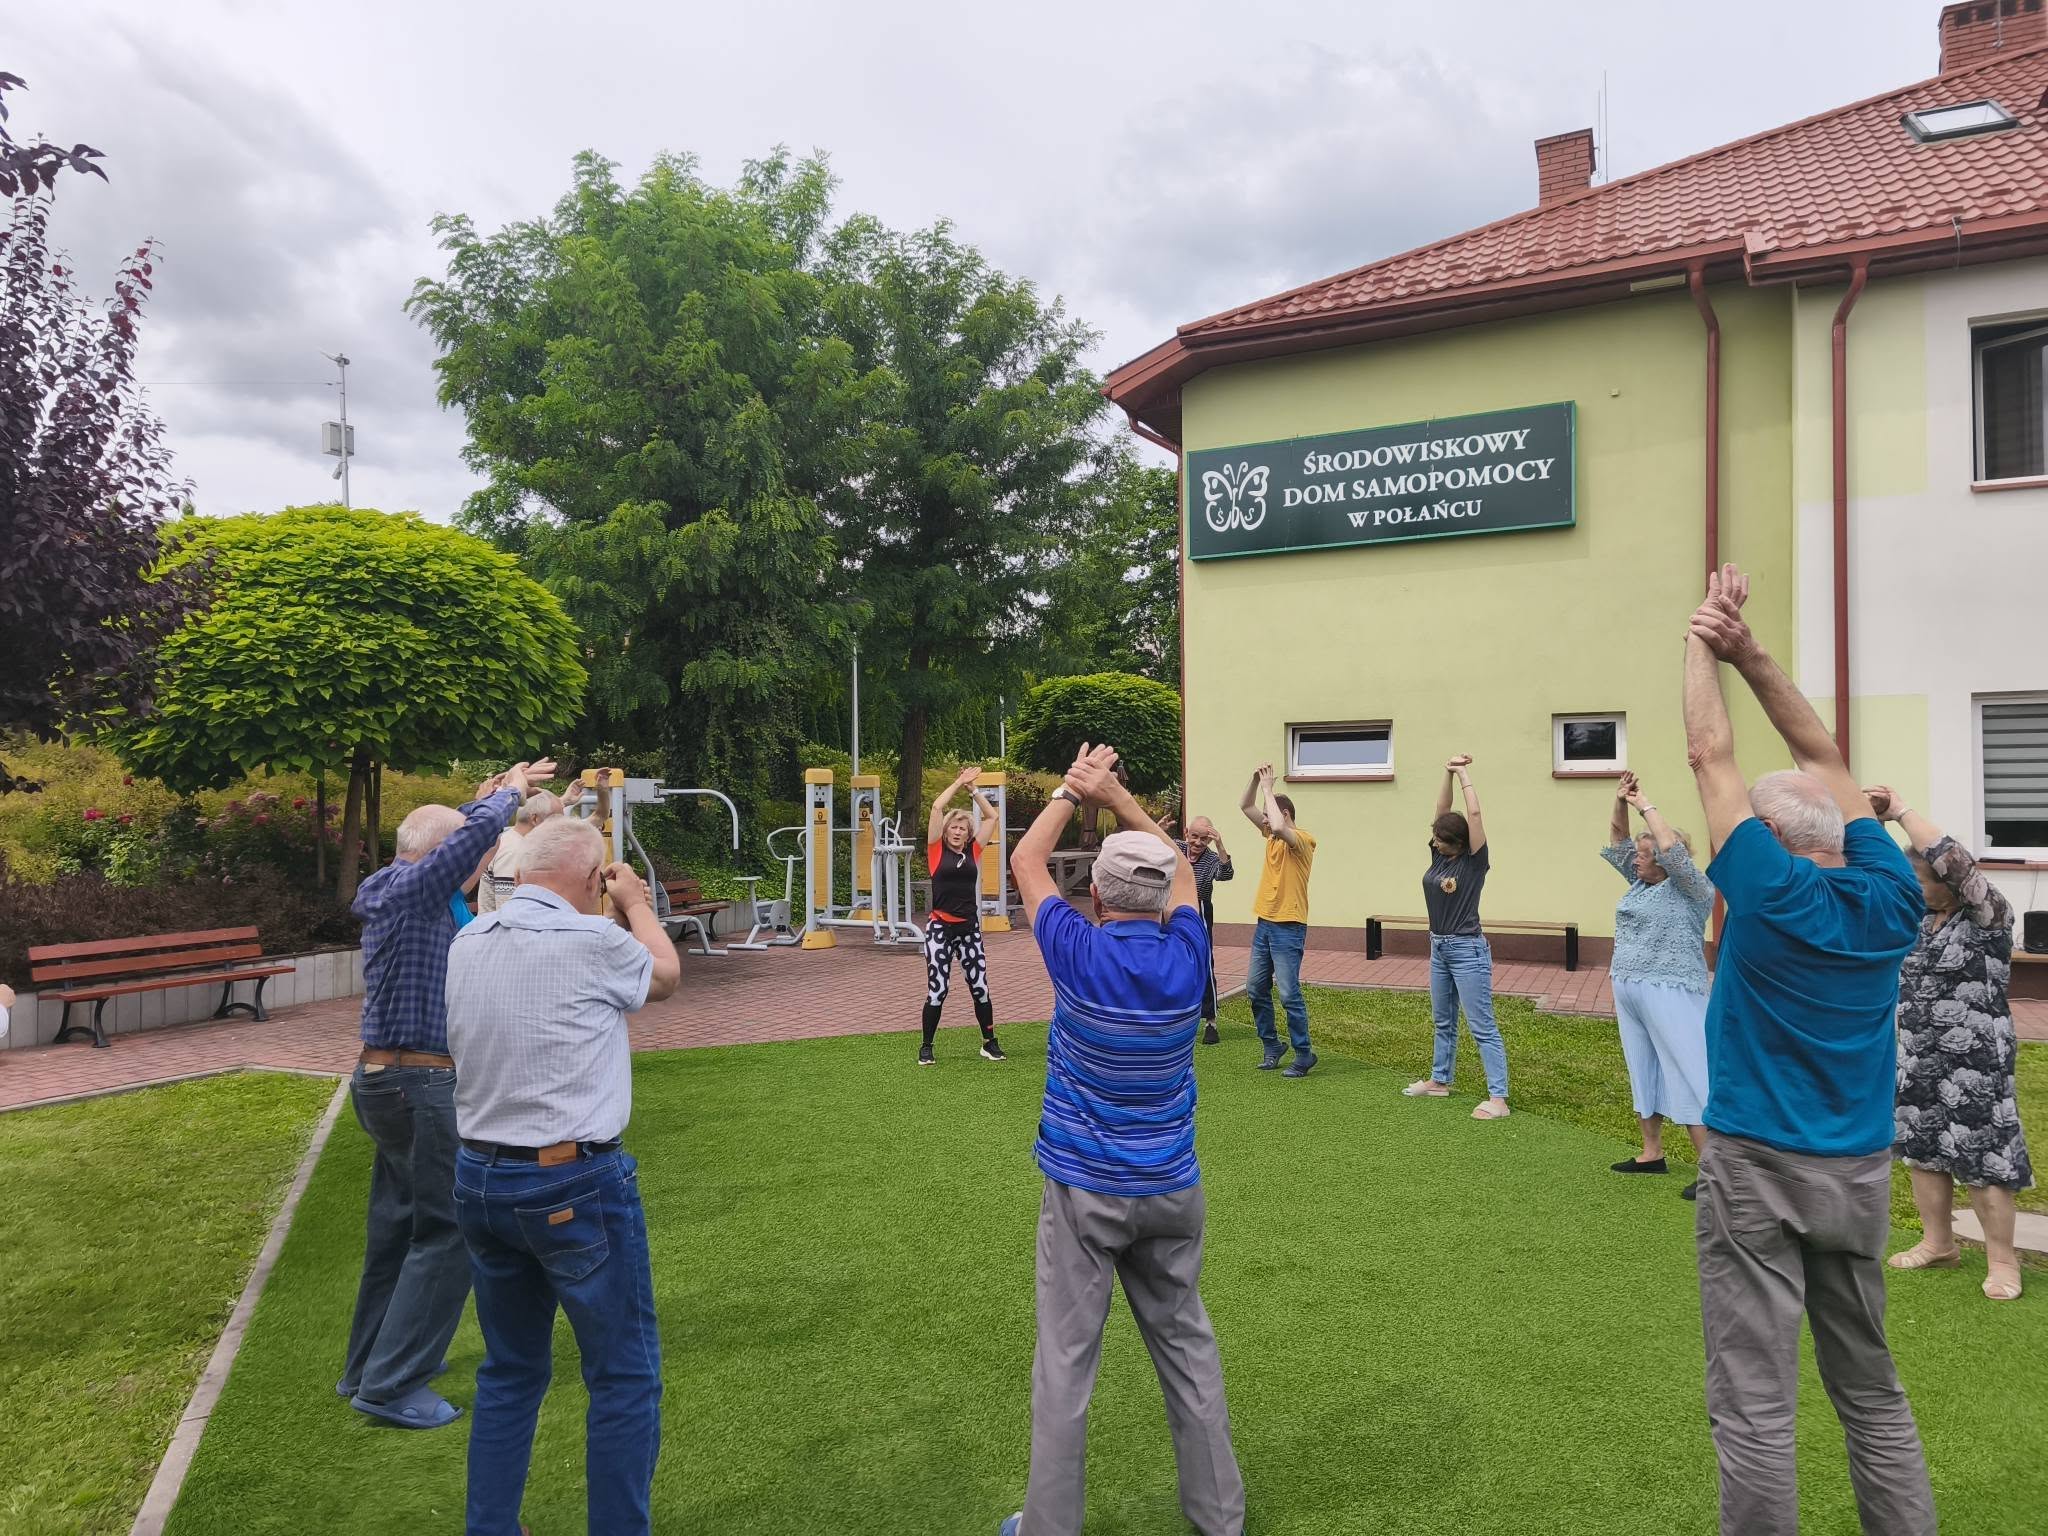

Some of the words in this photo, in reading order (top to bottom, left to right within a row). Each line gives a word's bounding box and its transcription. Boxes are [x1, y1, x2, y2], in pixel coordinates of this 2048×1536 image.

[1303, 428, 1531, 475] ŚRODOWISKOWY
[1283, 481, 1347, 508] DOM
[1352, 457, 1555, 501] SAMOPOMOCY
[1347, 510, 1370, 528] W
[1374, 499, 1484, 526] POŁAŃCU
